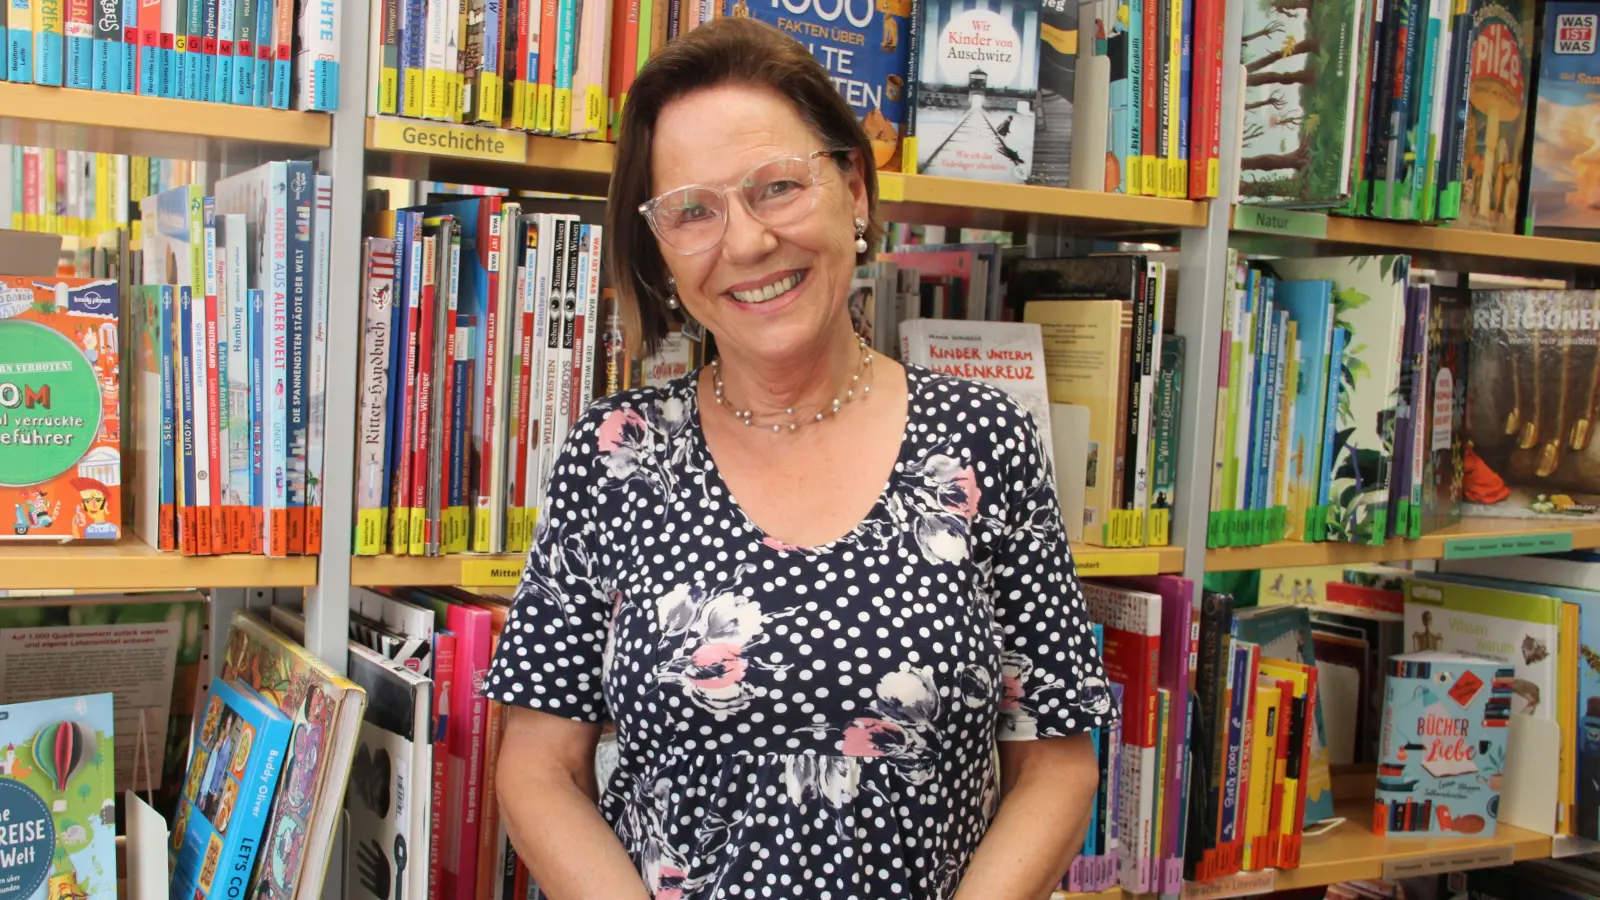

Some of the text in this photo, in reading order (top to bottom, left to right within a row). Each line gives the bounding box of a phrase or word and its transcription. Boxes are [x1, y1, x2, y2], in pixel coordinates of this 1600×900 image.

[766, 0, 874, 28] 00
[972, 20, 991, 32] Wir
[1562, 17, 1593, 27] WAS
[778, 18, 865, 46] FAKTEN ÜBER
[948, 32, 1013, 48] Kinder von
[1337, 22, 1346, 69] GERSTENBERG
[1566, 29, 1588, 39] IST
[797, 41, 853, 74] TE
[947, 47, 1012, 63] Auschwitz
[1402, 4, 1418, 106] Kreisläufe Natur
[1560, 41, 1590, 51] WAS
[408, 75, 416, 108] Geschichte
[1162, 60, 1170, 125] MAUERFALL
[559, 95, 567, 126] Geschichte
[402, 126, 505, 153] Geschichte
[491, 217, 499, 234] WAS
[1256, 212, 1289, 230] Natur
[395, 222, 405, 266] Mittelalter
[592, 237, 600, 257] WAS
[490, 253, 498, 270] WAS
[74, 296, 111, 306] lonely planet
[274, 207, 285, 370] KINDER AUS ALLER WELT
[560, 223, 579, 415] Sehen Staunen Wissen COWBOYS
[588, 299, 596, 323] BAND
[233, 307, 243, 352] Hamburg
[292, 248, 304, 423] DIE SPANNENDSTEN STÄDTE DER WELT
[315, 322, 323, 342] Japan
[487, 313, 495, 339] RITTER
[544, 223, 564, 445] Sehen Staunen Wissen WILDER WESTEN
[195, 322, 204, 388] Große Entdecker
[208, 321, 216, 369] DEUTSCHLAND
[486, 341, 494, 355] UND
[523, 336, 531, 366] STEINZEIT
[574, 338, 582, 368] INDIANER
[929, 344, 1033, 361] KINDER UNTERM
[15, 361, 72, 372] VERBOTEN!
[408, 348, 416, 386] MITTELALTER
[486, 357, 494, 386] BURGEN
[584, 364, 592, 391] WILDE
[930, 364, 1035, 380] HAKENKREUZ
[210, 378, 218, 393] Land
[218, 345, 227, 428] Arktis Antarktis
[366, 322, 386, 444] Ritter-Handbuch
[420, 372, 430, 411] Wikinger
[1160, 369, 1173, 418] DUNKELHEIT
[14, 414, 84, 427] verrückte
[163, 416, 172, 447] ASIEN
[184, 418, 192, 456] EUROPA
[210, 426, 218, 459] entdecken
[272, 422, 281, 453] UNICEF
[491, 568, 521, 578] Mittel
[52, 631, 112, 640] Quadratmetern
[113, 629, 137, 637] autark
[1449, 617, 1488, 636] Wissen
[42, 641, 68, 650] eigene
[70, 638, 121, 647] Lebensmittel
[123, 637, 156, 645] anbauen
[472, 702, 481, 717] der
[471, 718, 481, 734] Buch
[1147, 712, 1156, 744] Mensch
[1417, 713, 1469, 736] BÜCHER
[468, 735, 480, 785] Ravensburger
[1228, 745, 1239, 773] BOOK
[1242, 718, 1253, 782] LIES MAL VOR!
[1426, 738, 1477, 762] Liebe
[258, 749, 278, 782] Buddy
[252, 783, 268, 818] Oliver
[433, 781, 441, 807] WELT
[467, 786, 477, 808] große
[432, 812, 440, 829] DER
[466, 809, 475, 823] Das
[0, 846, 35, 868] Welt
[234, 836, 255, 872] LET'S
[430, 834, 438, 864] BILDER
[7, 874, 20, 885] über
[429, 868, 438, 886] FÜR
[1232, 877, 1271, 891] Literatur
